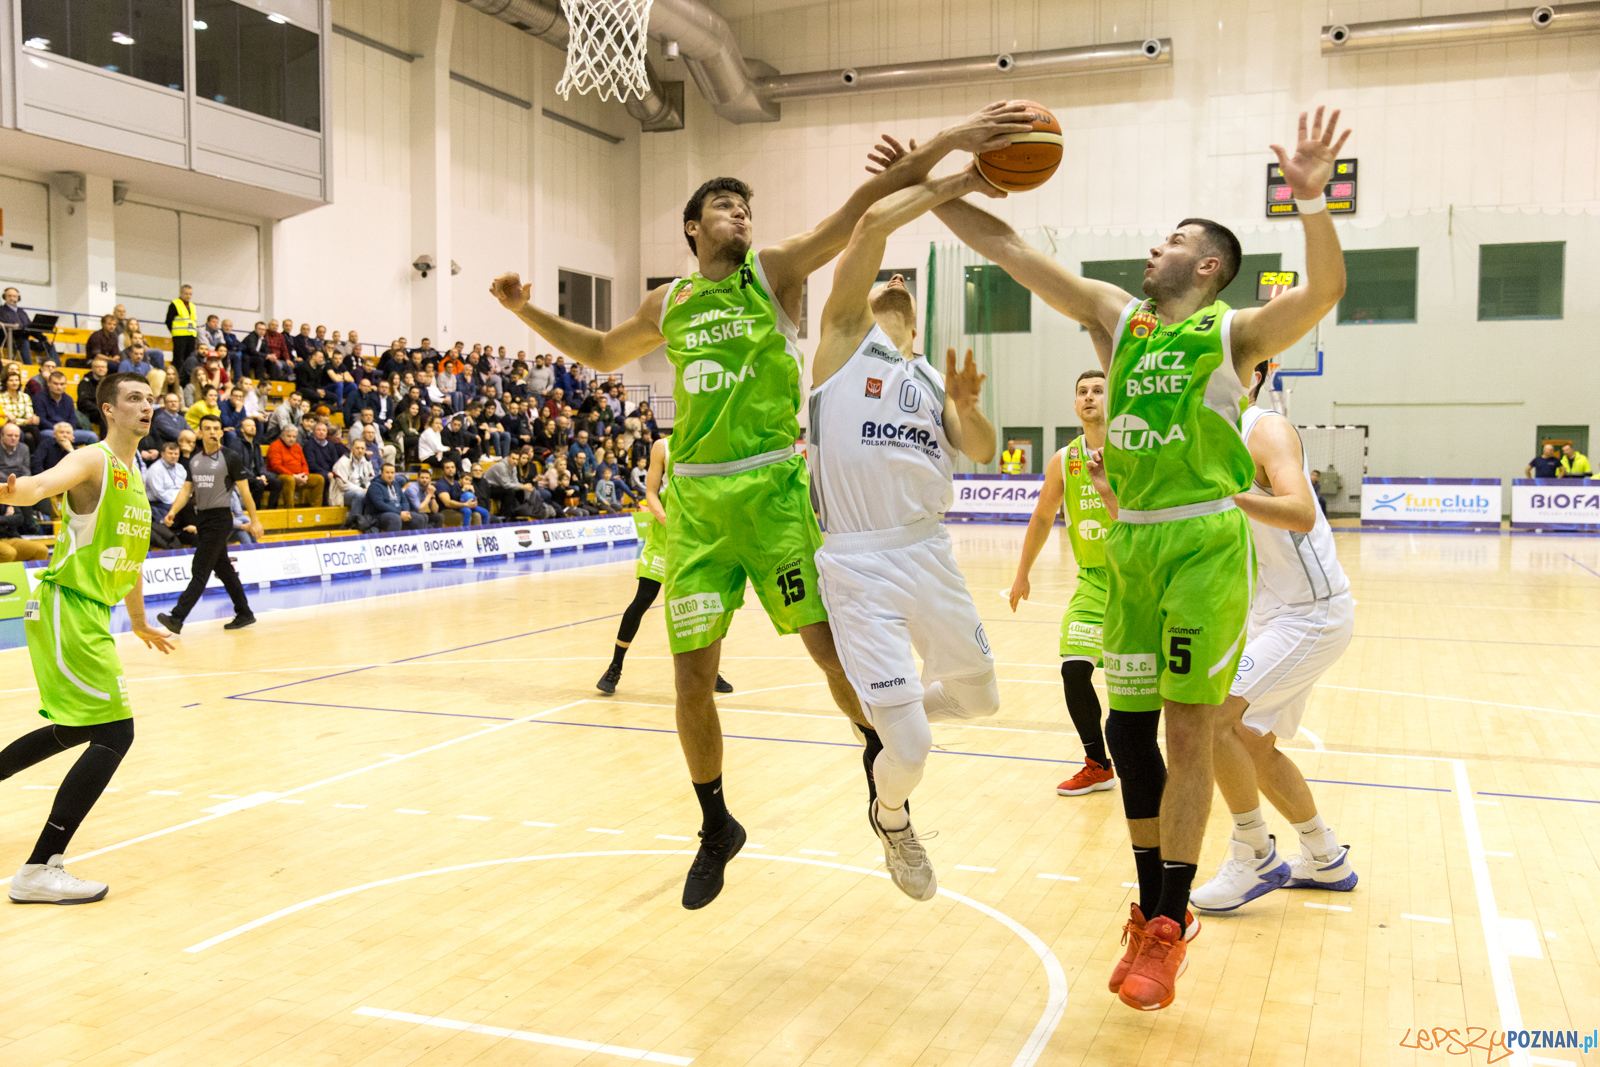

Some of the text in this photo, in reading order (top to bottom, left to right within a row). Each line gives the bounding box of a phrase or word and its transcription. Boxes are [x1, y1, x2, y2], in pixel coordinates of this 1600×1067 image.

[100, 281, 108, 292] B
[689, 306, 745, 328] ZNICZ
[1194, 314, 1216, 331] 5
[685, 319, 756, 350] BASKET
[861, 438, 887, 447] POLSKI
[1405, 493, 1490, 508] funclub
[551, 529, 576, 541] NICKEL
[375, 543, 419, 557] BIOFARM
[424, 539, 464, 552] BIOFARM
[482, 536, 499, 552] PBG
[777, 568, 806, 607] 15
[672, 599, 698, 616] LOGO
[1169, 636, 1191, 675] 5
[870, 676, 906, 690] macron
